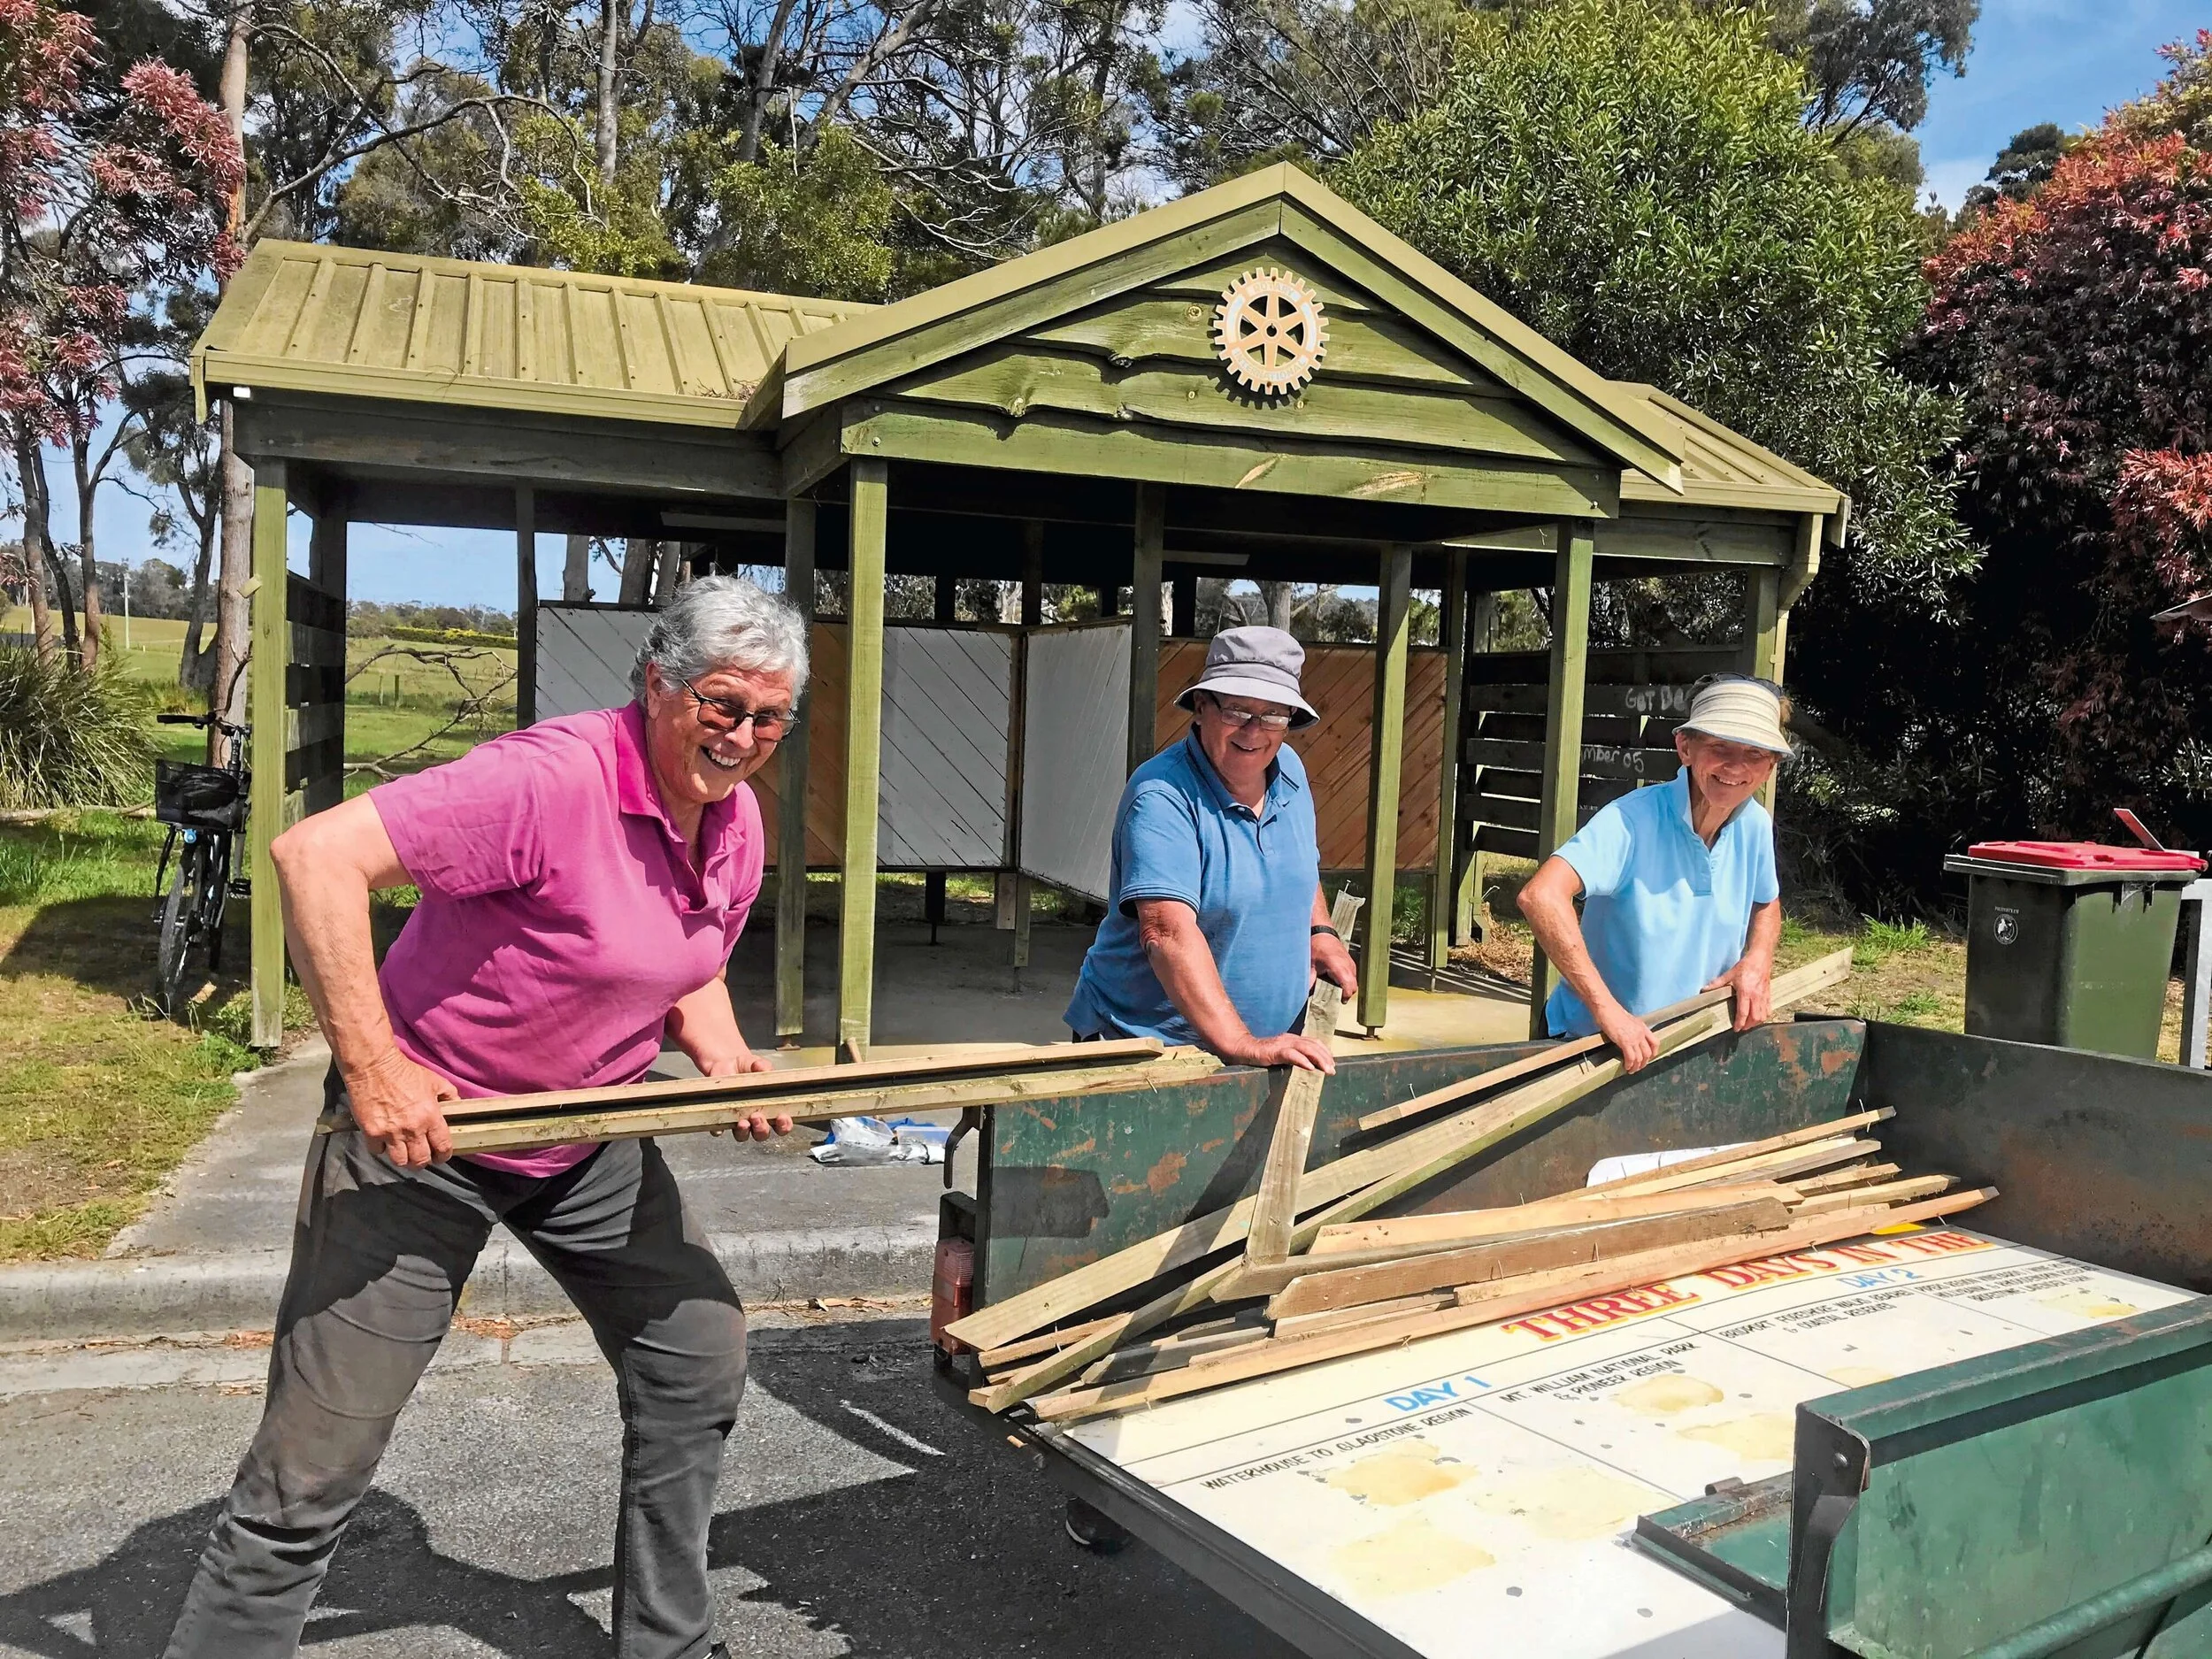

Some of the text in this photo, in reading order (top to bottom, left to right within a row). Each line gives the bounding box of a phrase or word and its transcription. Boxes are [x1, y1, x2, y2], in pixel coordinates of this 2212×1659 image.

[1581, 747, 1620, 764] mber
[1502, 1232, 1993, 1341] THREE DAYS IN THE
[1836, 1268, 1924, 1289] DAY 2
[1383, 1375, 1493, 1412] DAY 1
[1499, 1341, 1701, 1404] MT. WILLIAM NATIONAL PARK
[1553, 1359, 1683, 1402] & PIONEER REGION
[1200, 1408, 1474, 1490] WATERHOUSE TO GLADSTONE REGION
